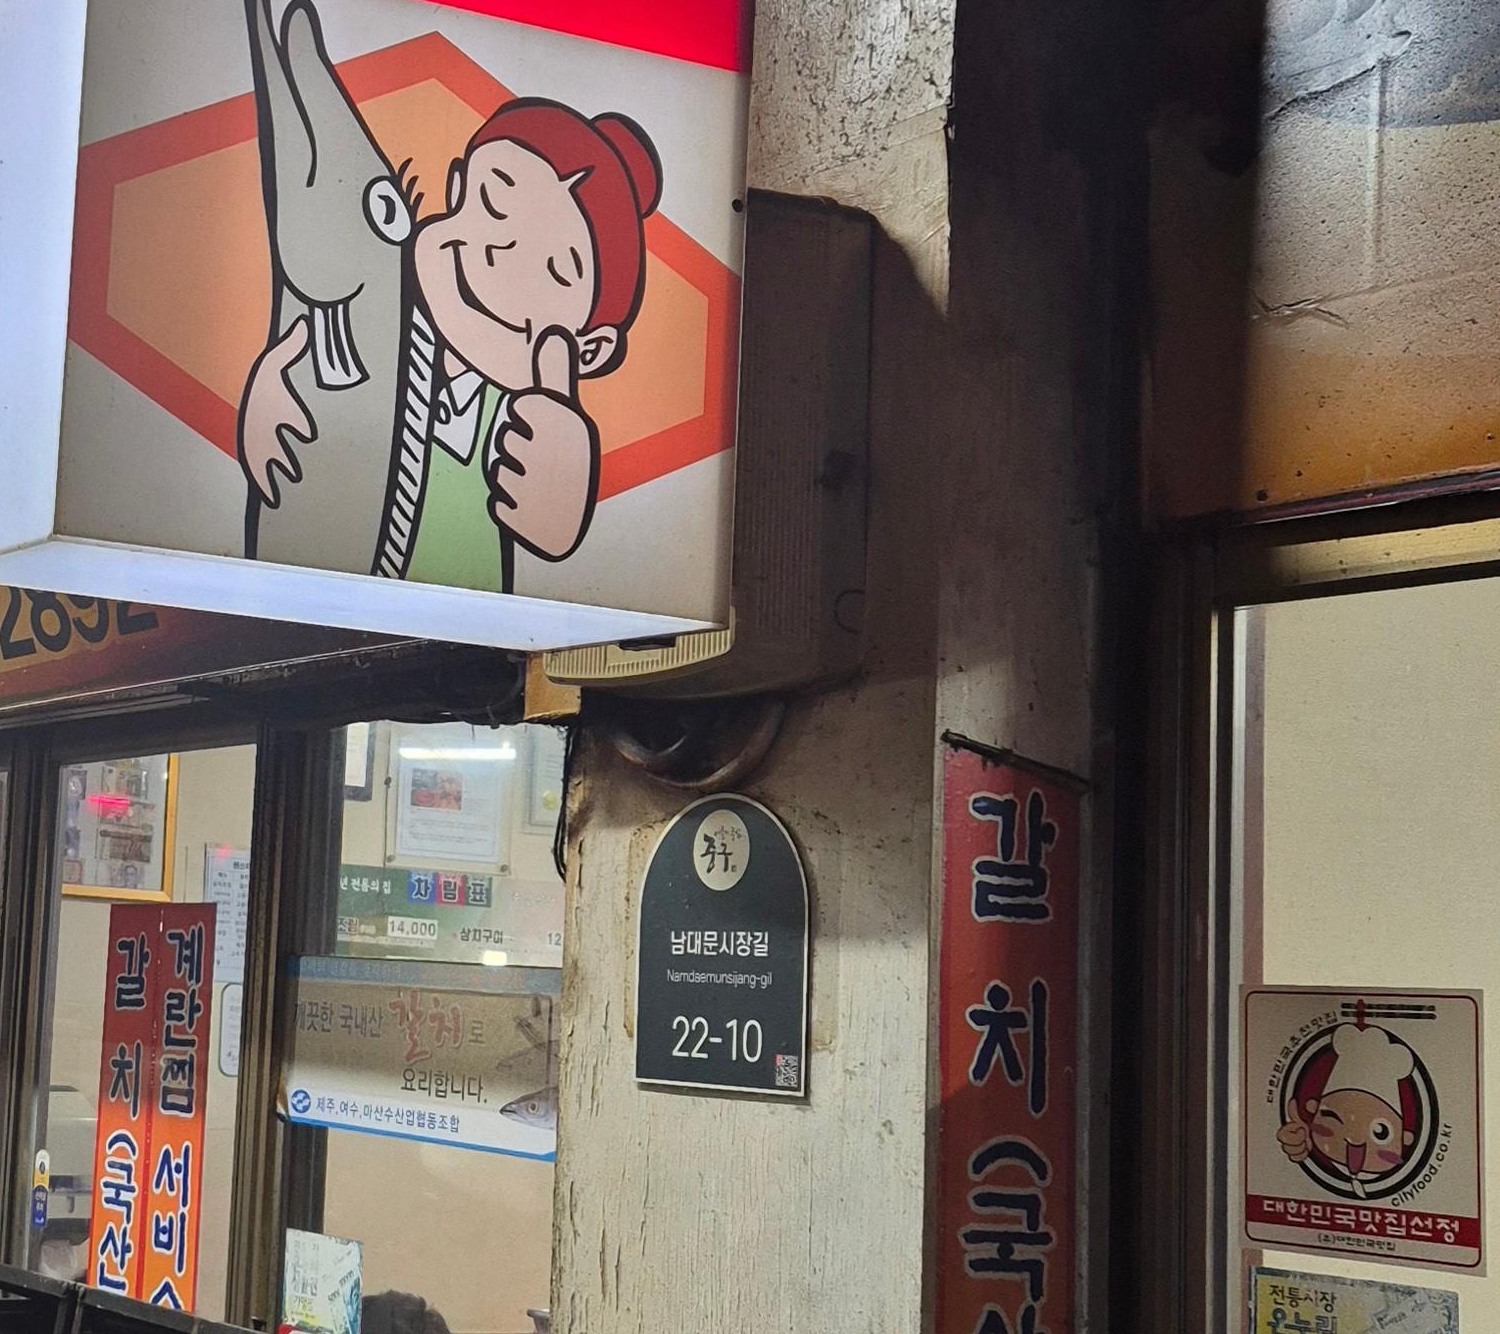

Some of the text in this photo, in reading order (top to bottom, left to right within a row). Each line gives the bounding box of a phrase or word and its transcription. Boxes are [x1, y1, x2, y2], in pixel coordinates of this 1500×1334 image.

[700, 833, 732, 874] 중구
[412, 876, 488, 904] 차림표
[389, 920, 437, 938] 14,000
[460, 927, 562, 946] 삼치구이 12
[670, 931, 770, 957] 남대문시장길
[667, 969, 772, 989] Namdaemunsijang-gil
[159, 922, 204, 1119] 계란찜
[294, 1001, 334, 1034] 깨끗한
[339, 1003, 383, 1038] 국내산
[671, 1015, 763, 1063] 22-10
[1266, 1011, 1338, 1104] 대한민국추천맛집
[400, 1067, 488, 1104] 요리합니다.
[1391, 1122, 1453, 1207] cityfood.co.kr
[1263, 1199, 1460, 1244] 대한민국맛집선정
[1268, 1284, 1337, 1314] 전통시장
